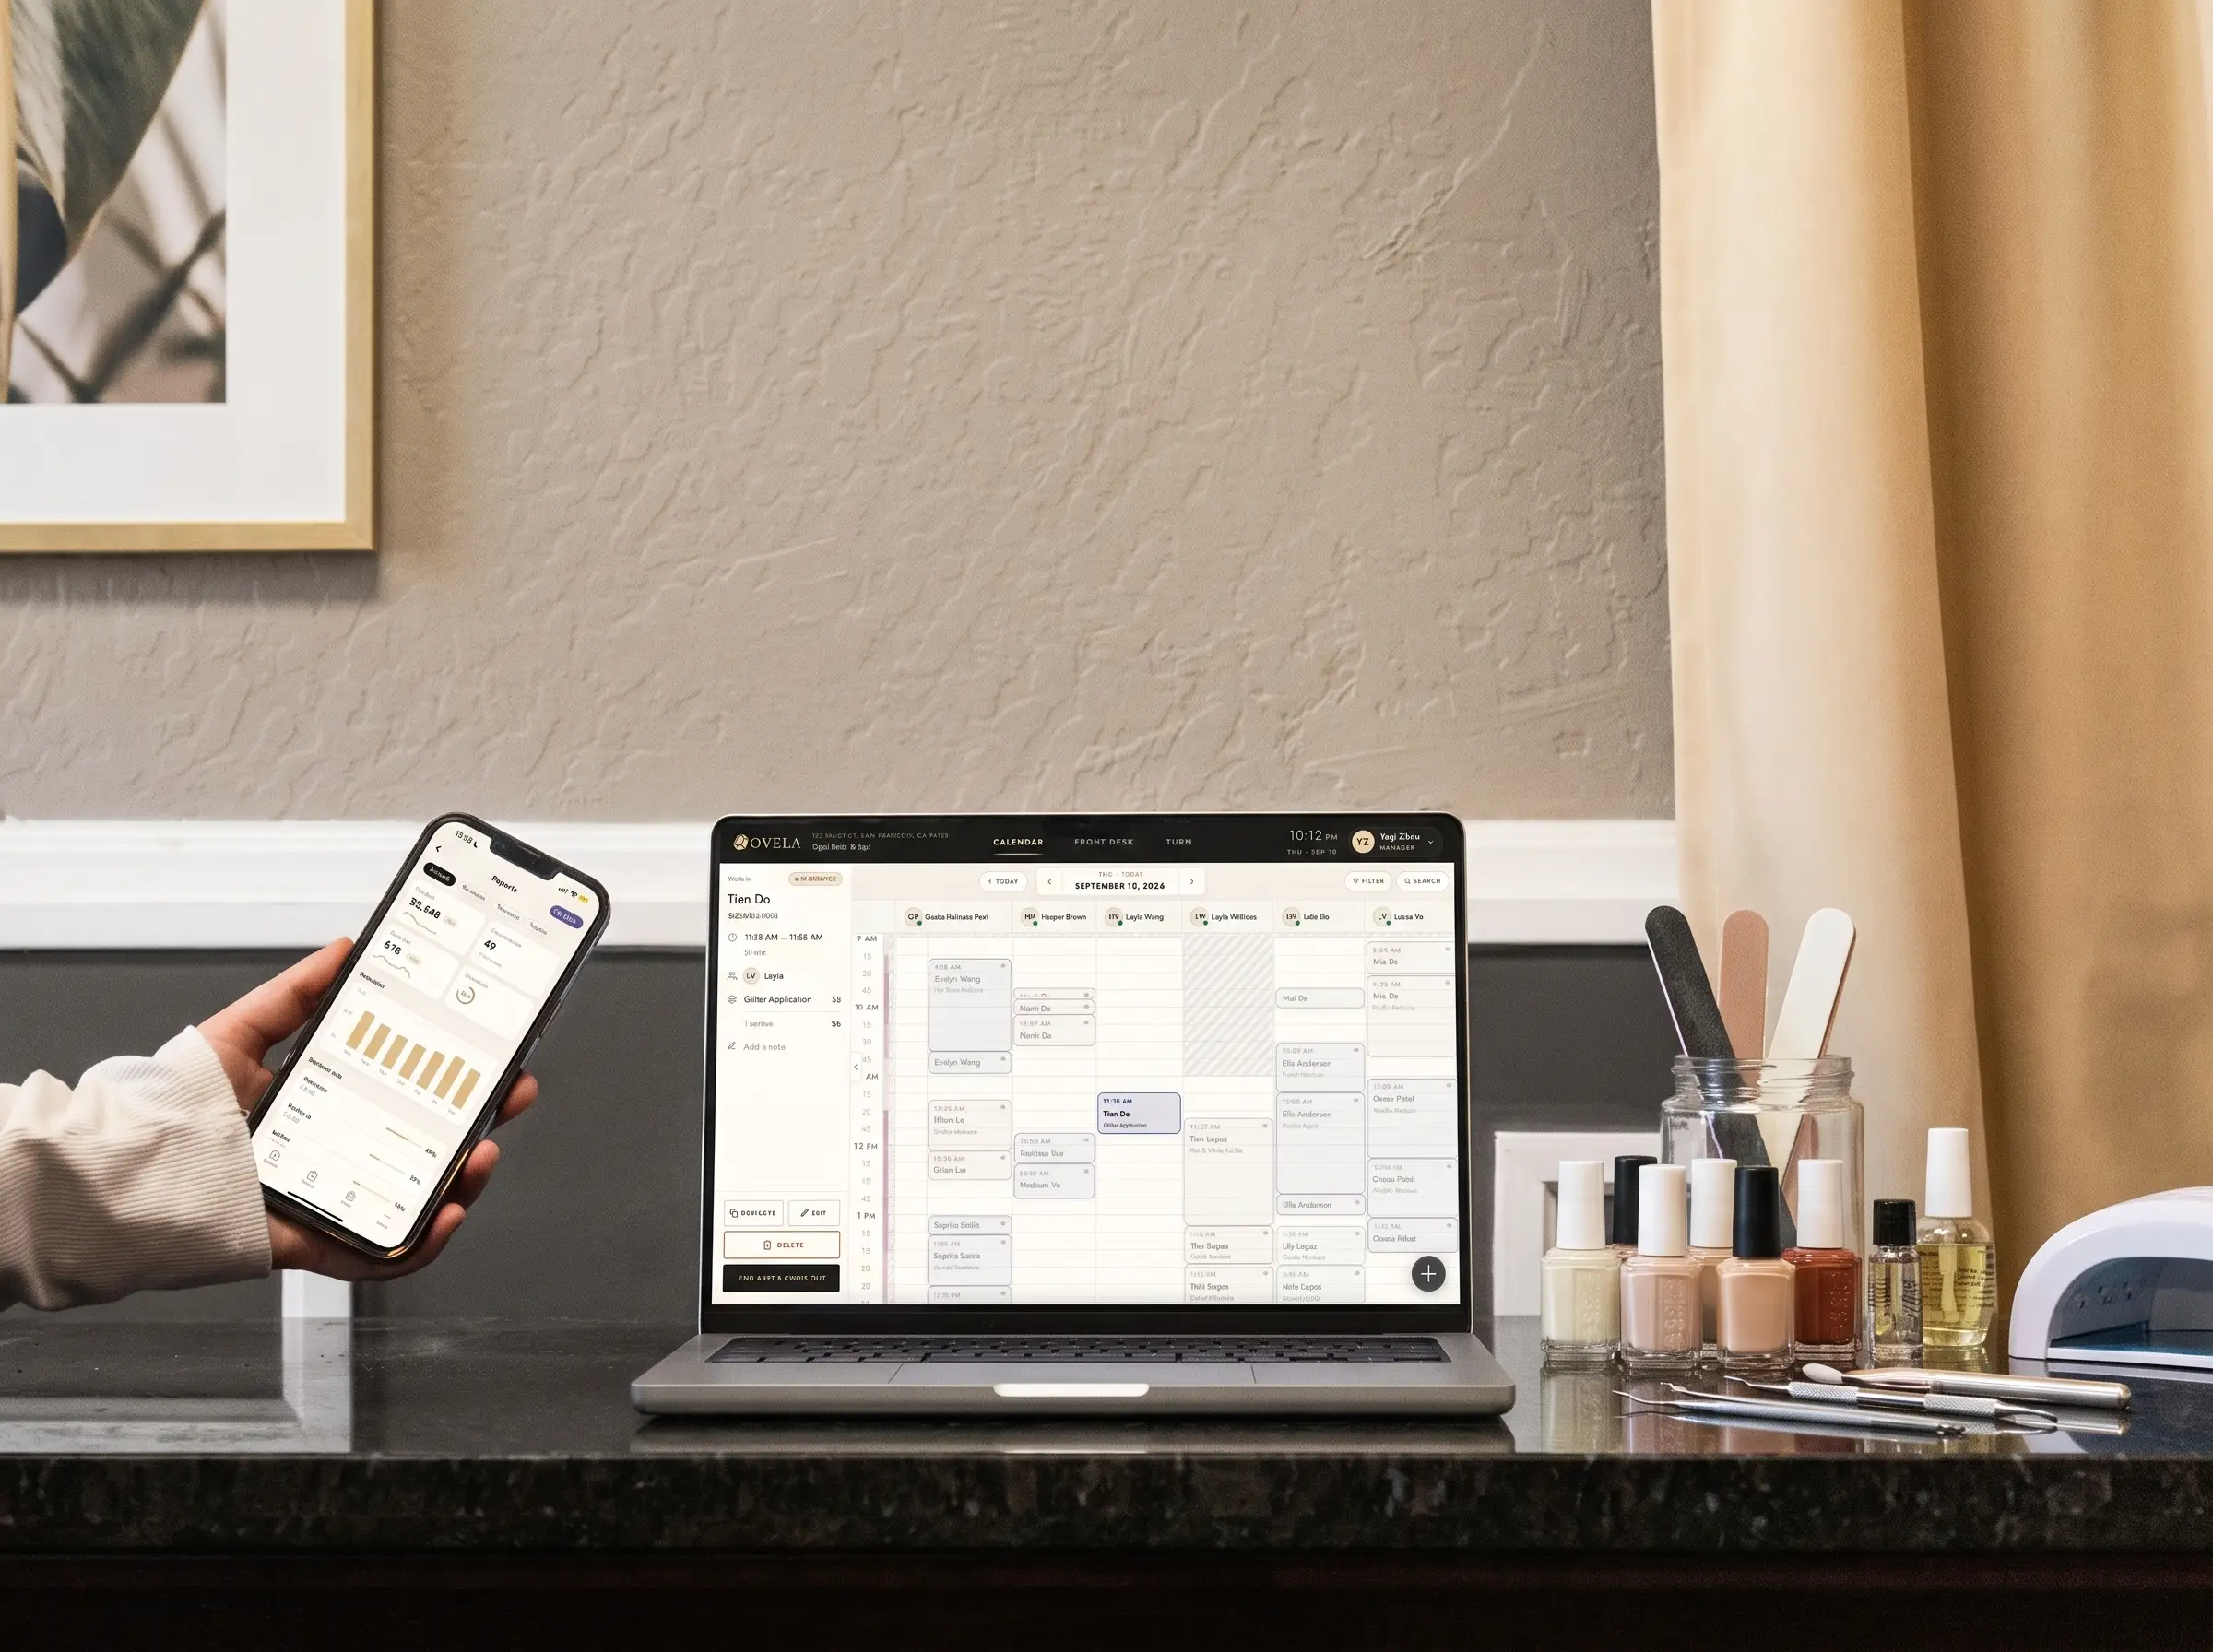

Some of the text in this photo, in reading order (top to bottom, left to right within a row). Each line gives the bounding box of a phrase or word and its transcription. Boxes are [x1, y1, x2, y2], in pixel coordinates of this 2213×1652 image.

[1290, 831, 1321, 840] 10:12
[751, 838, 800, 848] OVELA
[1357, 838, 1369, 846] YZ
[728, 894, 770, 903] Tien Do
[484, 940, 496, 950] 49
[959, 976, 981, 984] Wang
[769, 996, 812, 1004] Application
[959, 1059, 981, 1067] Wang
